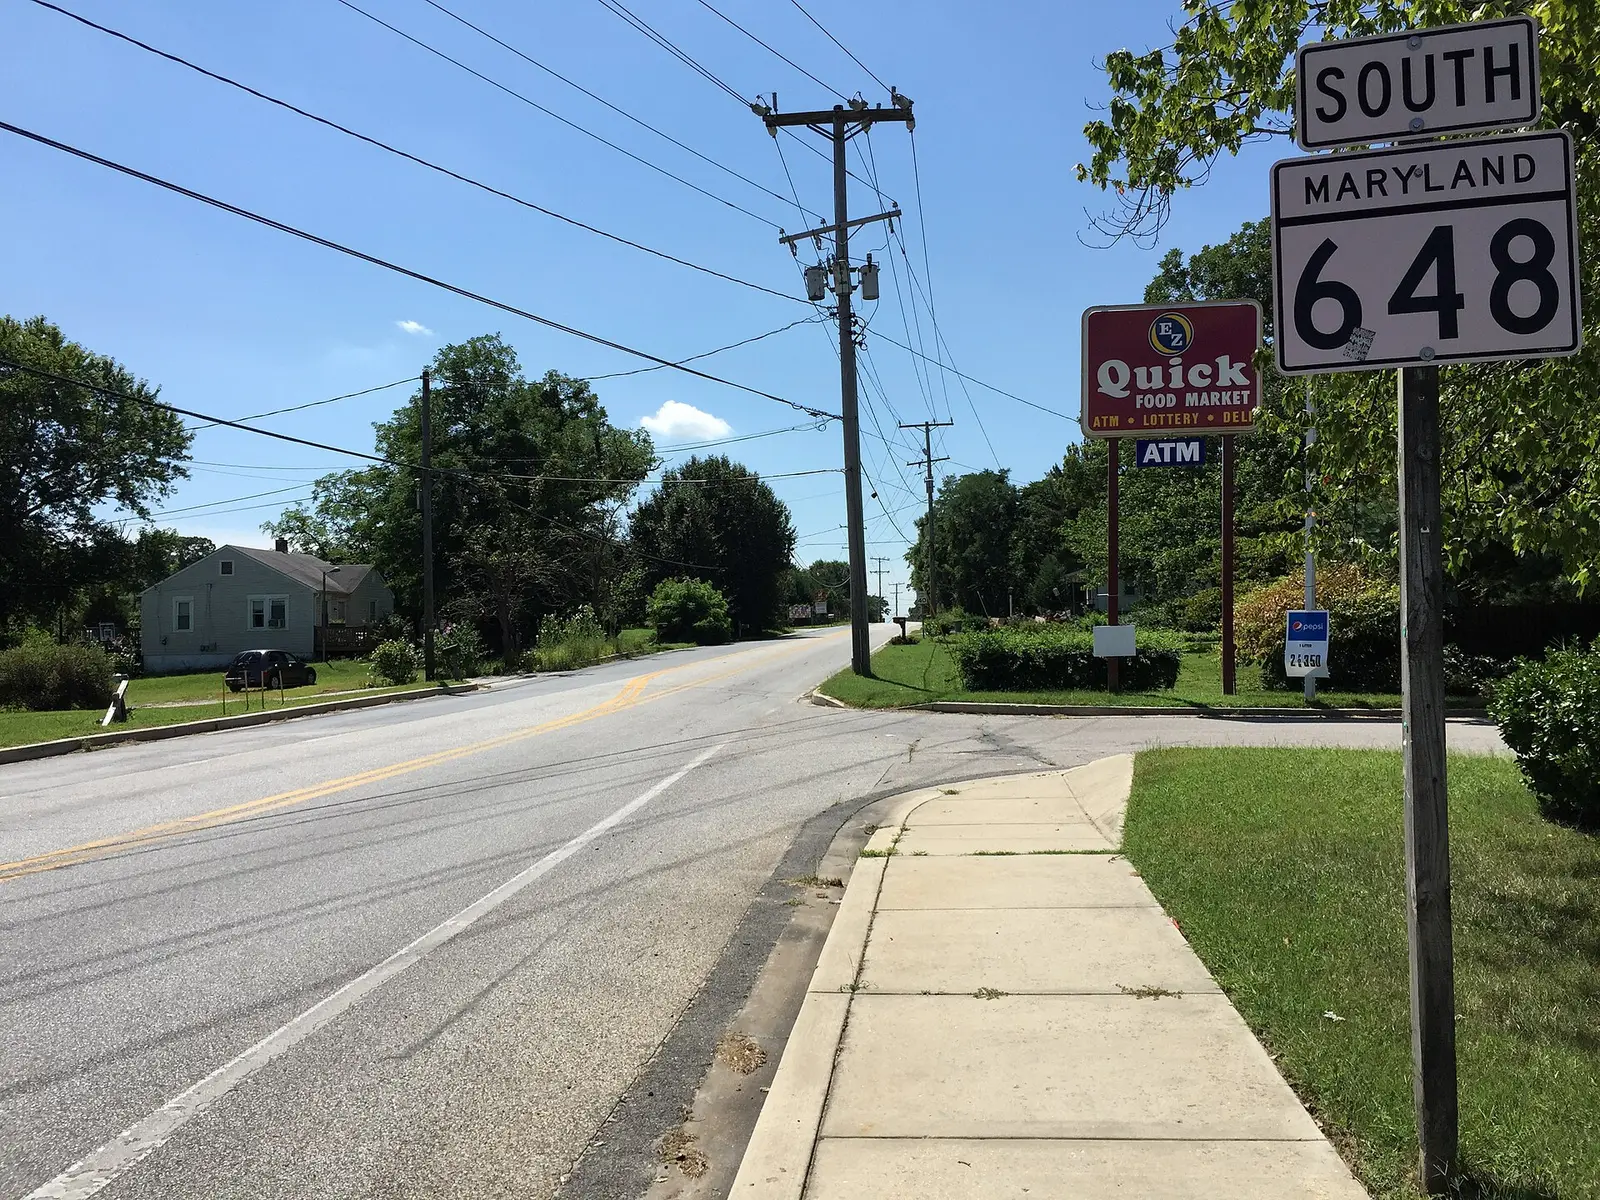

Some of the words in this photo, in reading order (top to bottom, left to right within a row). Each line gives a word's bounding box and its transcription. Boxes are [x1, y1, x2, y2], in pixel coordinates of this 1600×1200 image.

[1315, 43, 1521, 123] SOUTH
[1304, 154, 1536, 205] MARYLAND
[1293, 218, 1560, 351] 648
[1097, 355, 1251, 398] Quick
[1092, 415, 1119, 428] ATM
[1143, 412, 1199, 426] LOTTERY
[1223, 410, 1253, 423] DELI
[1135, 394, 1176, 409] FOOD
[1185, 390, 1250, 408] MARKET
[1142, 441, 1200, 463] ATM
